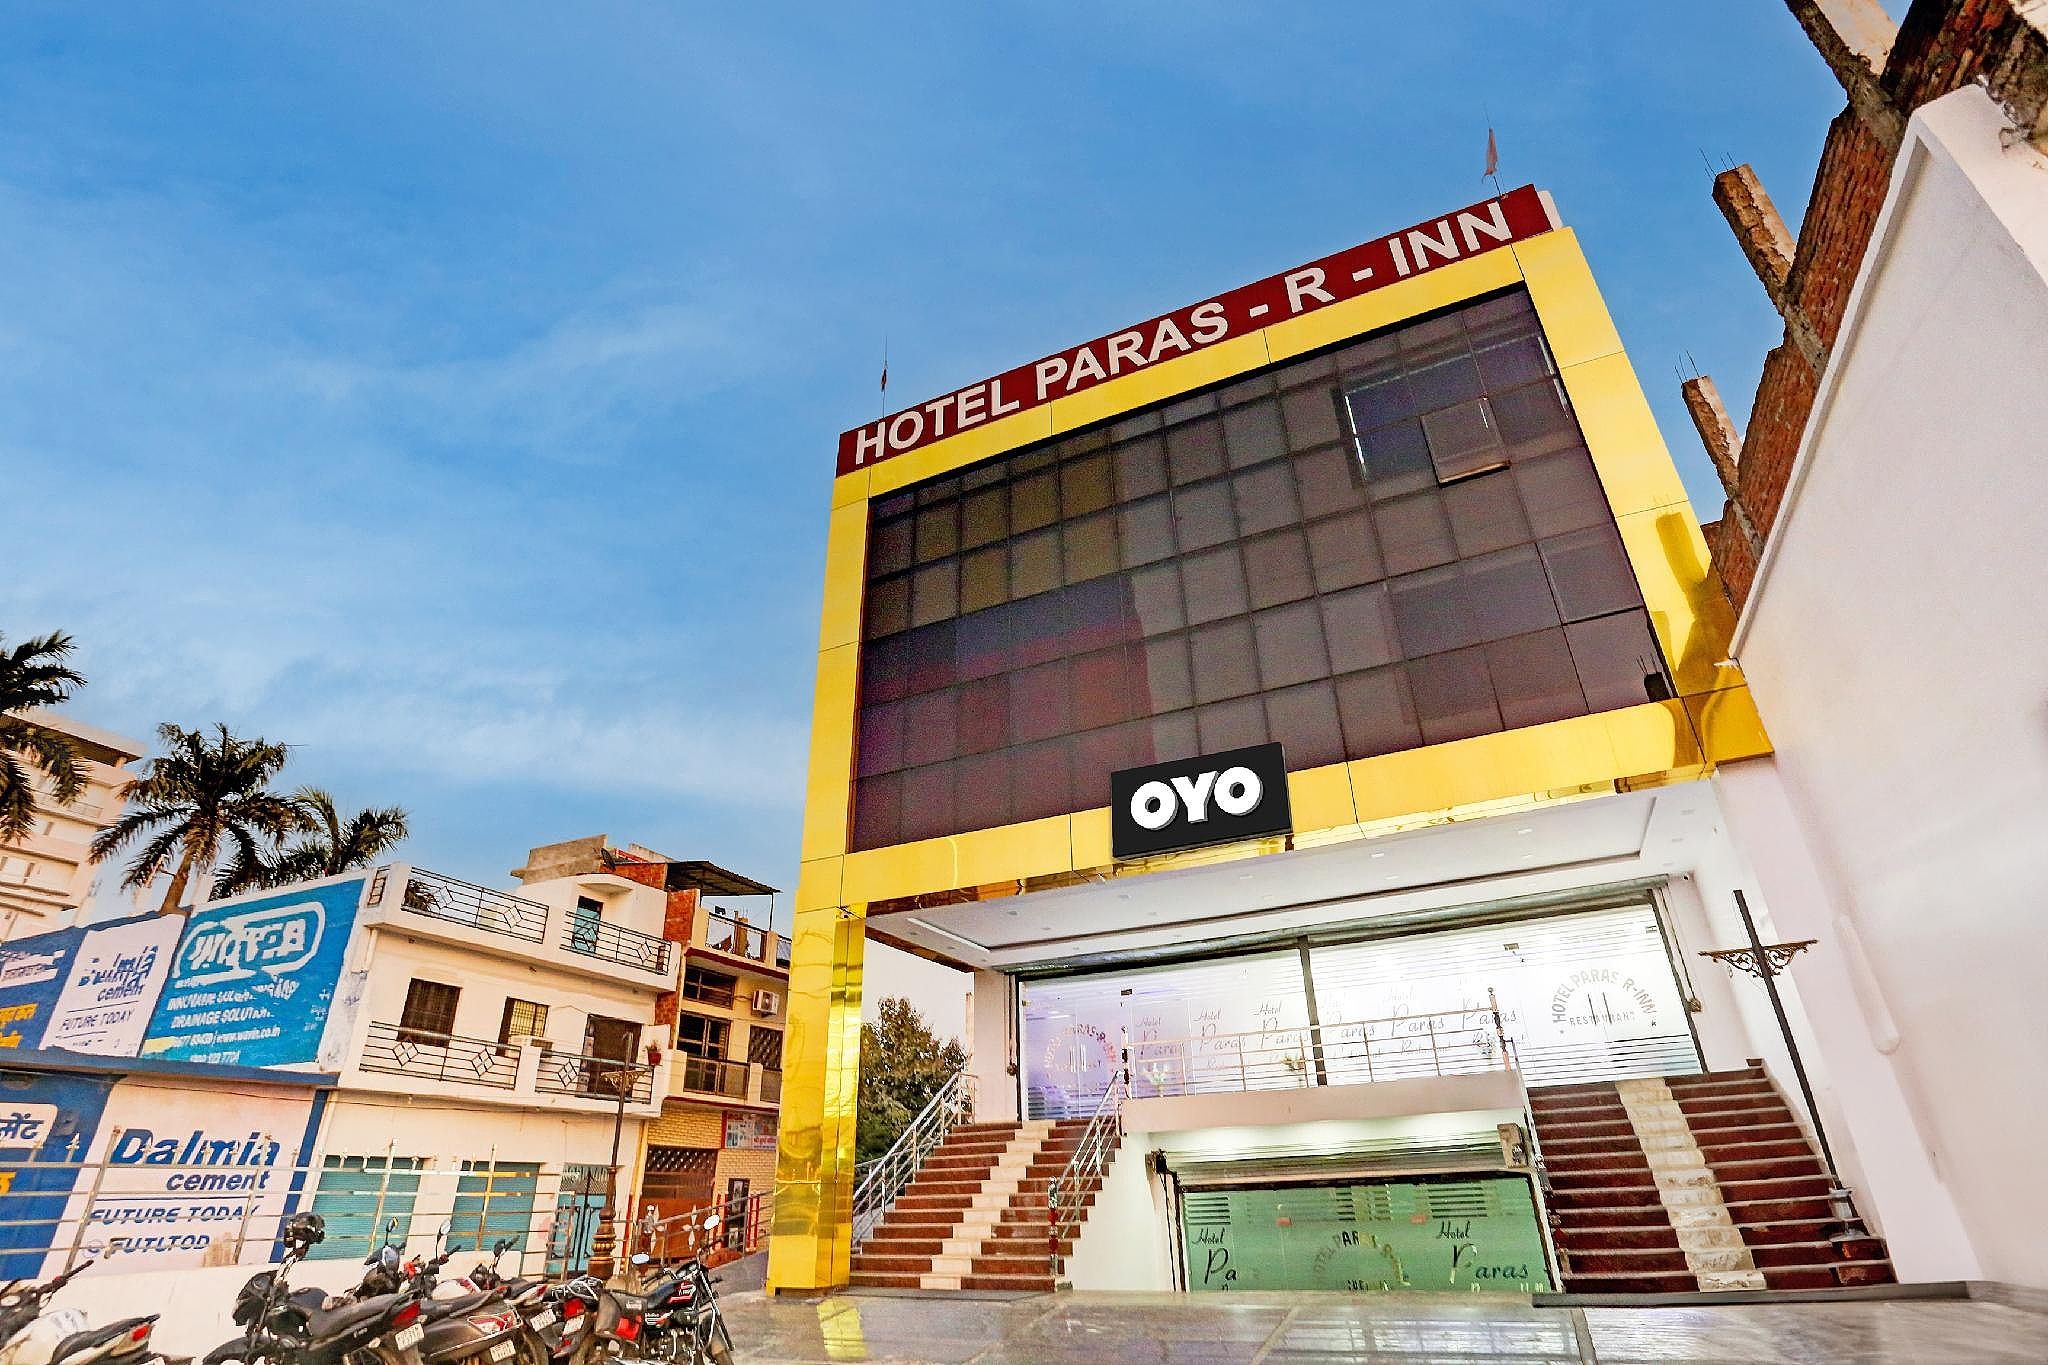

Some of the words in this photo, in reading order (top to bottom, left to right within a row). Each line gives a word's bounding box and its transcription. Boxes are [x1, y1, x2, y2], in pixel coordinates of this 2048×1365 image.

[855, 379, 1020, 465] HOTEL
[1035, 302, 1229, 401] PARAS
[1284, 267, 1336, 314] R
[1388, 200, 1513, 277] INN
[1130, 766, 1264, 831] OYO
[1551, 983, 1577, 1024] HOTEL
[1569, 968, 1620, 988] PARAS
[100, 1008, 136, 1026] TODAY
[111, 1128, 281, 1166] Dalmia
[166, 1169, 271, 1192] cement
[87, 1207, 181, 1226] FUTURE
[1191, 1227, 1225, 1244] Hotel
[1436, 1220, 1470, 1240] Hotel
